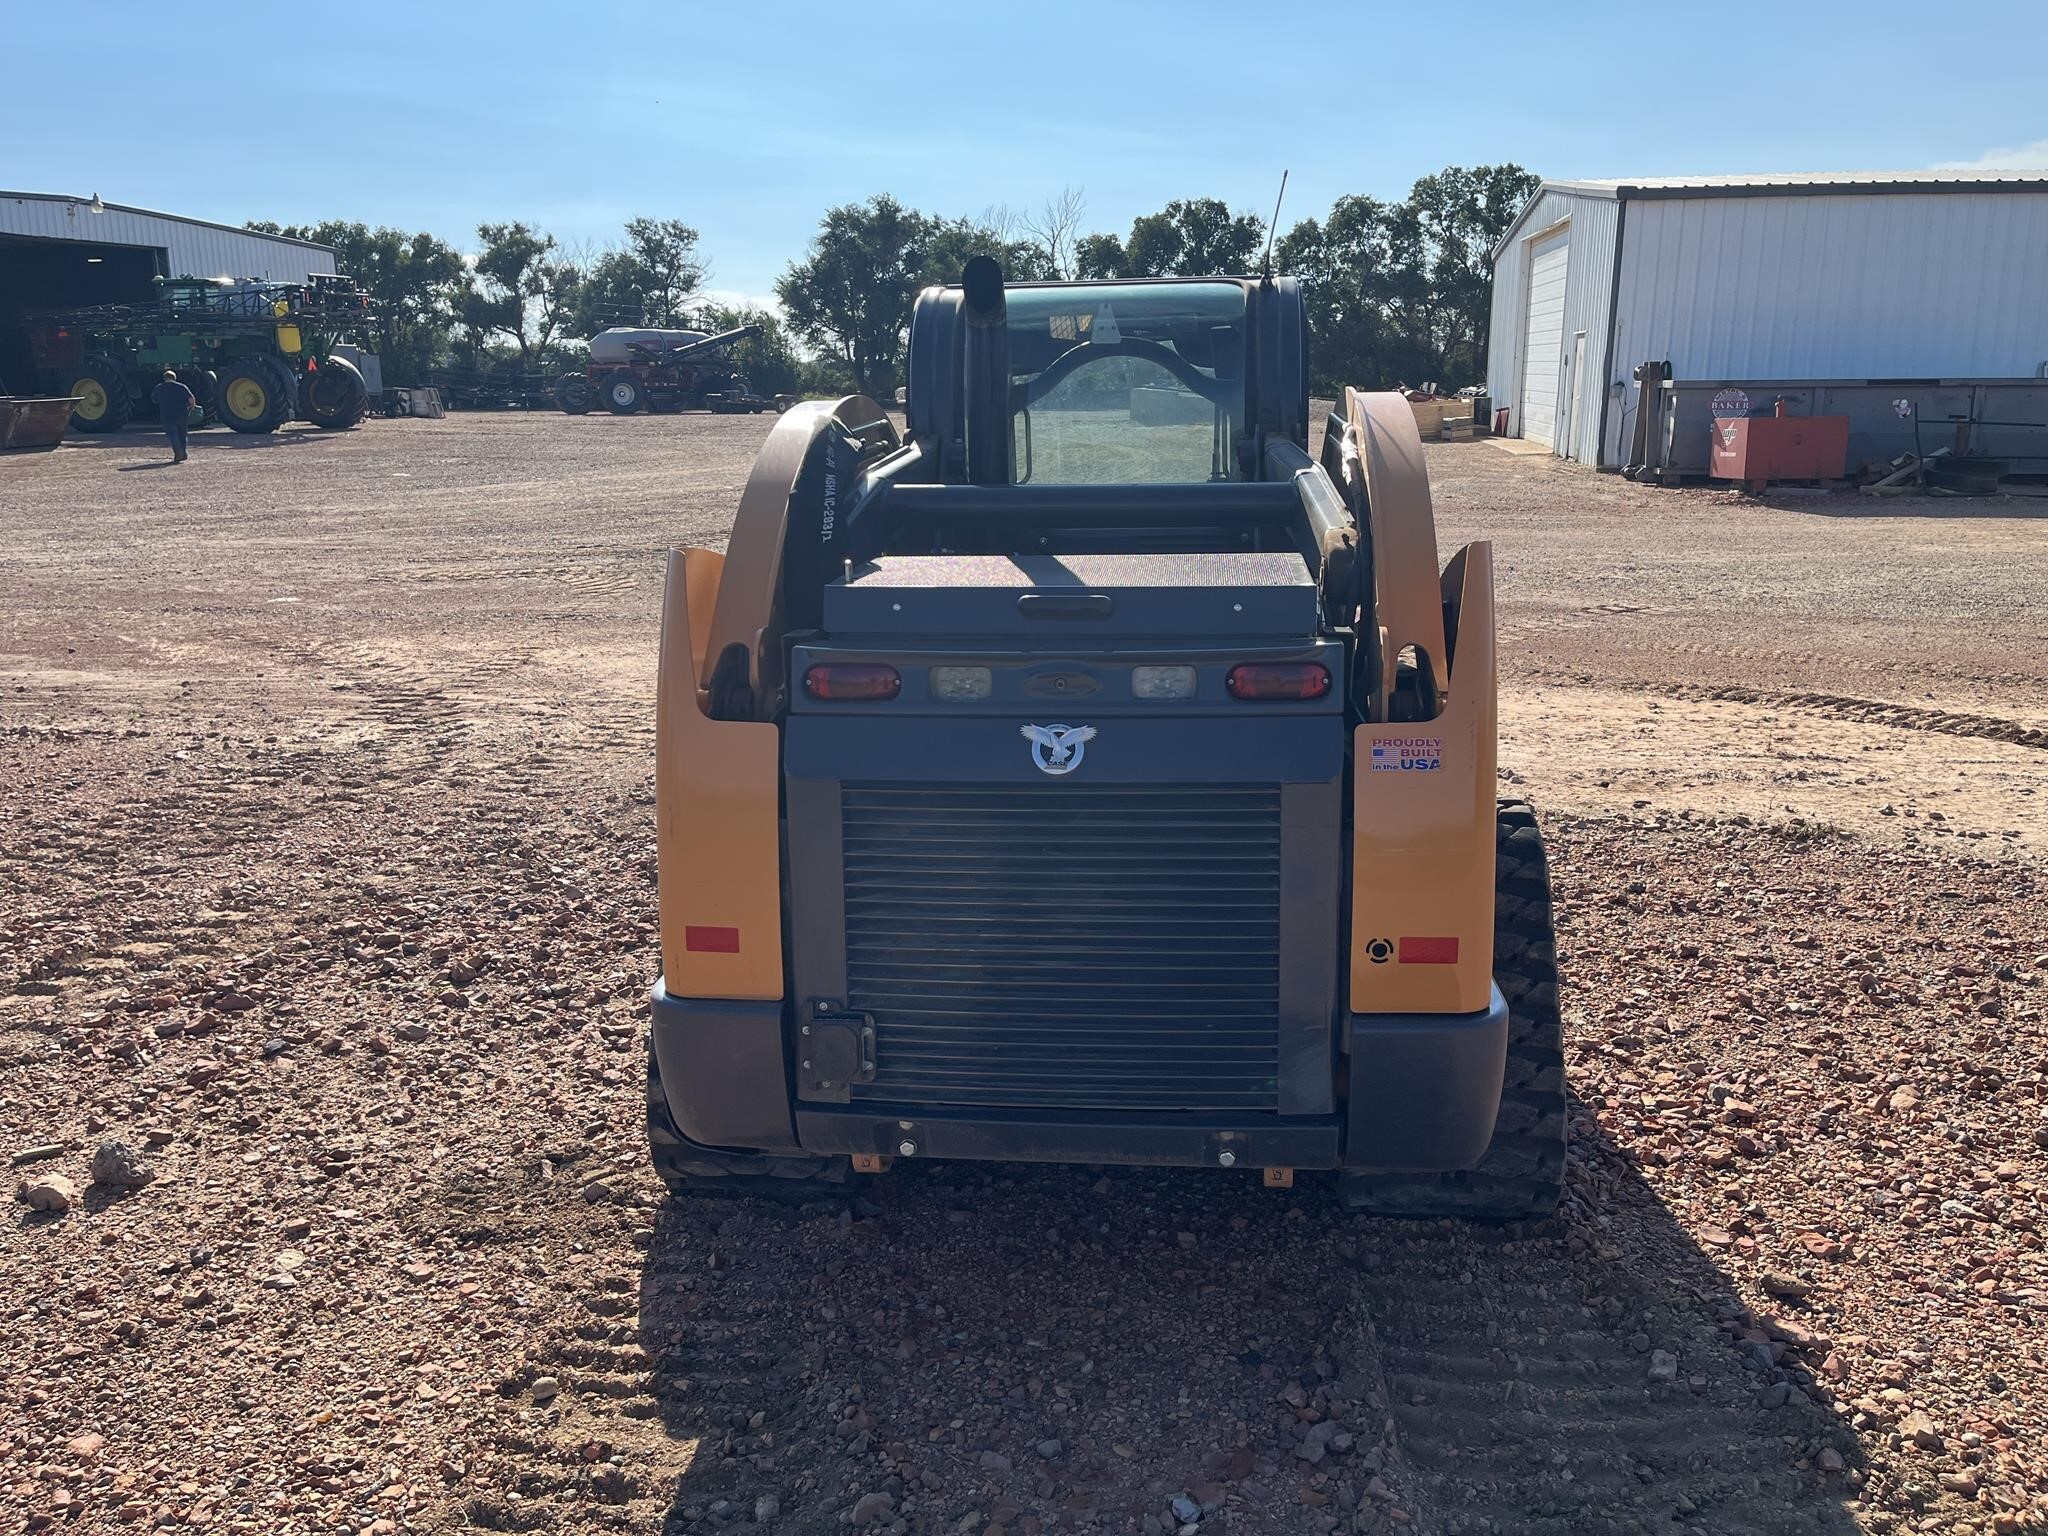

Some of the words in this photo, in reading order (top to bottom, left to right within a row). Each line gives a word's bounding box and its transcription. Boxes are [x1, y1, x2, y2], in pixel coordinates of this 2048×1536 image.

[1372, 738, 1442, 747] PROUDLY
[1400, 748, 1442, 757] BUILT
[1400, 758, 1441, 770] USA
